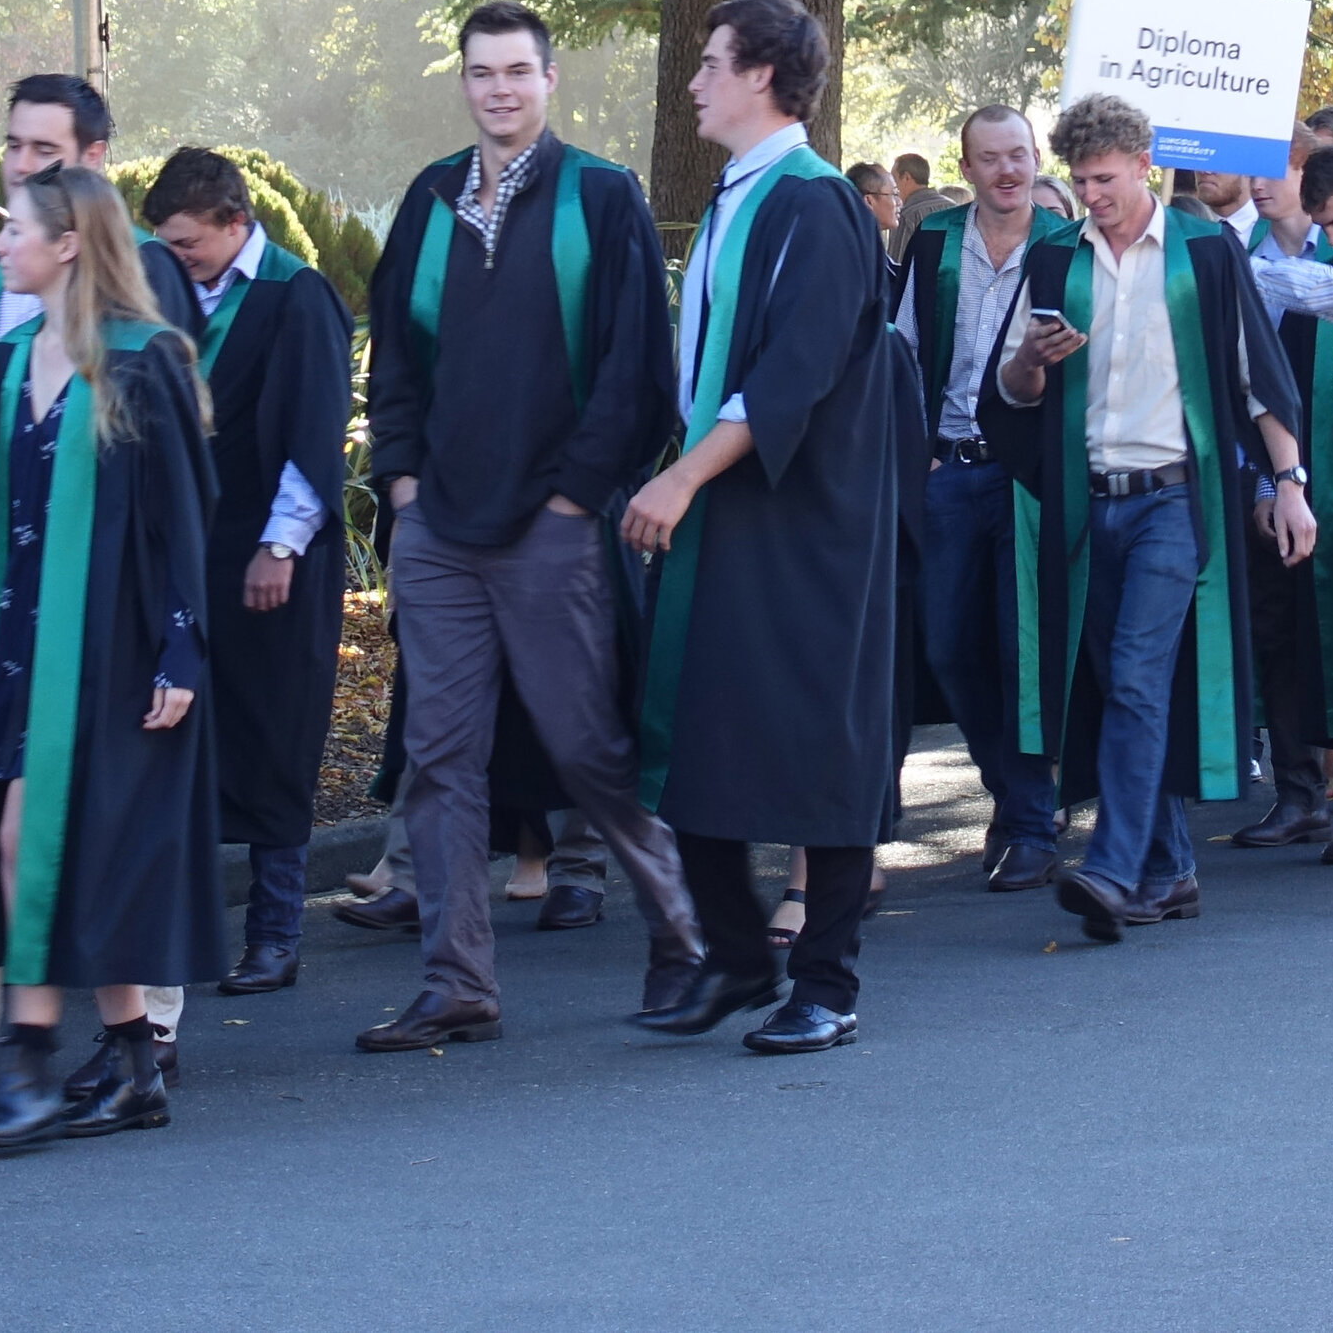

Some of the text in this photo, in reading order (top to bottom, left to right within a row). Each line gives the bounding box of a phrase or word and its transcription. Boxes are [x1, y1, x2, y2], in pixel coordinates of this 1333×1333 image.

[1137, 27, 1241, 60] Diploma
[1098, 55, 1270, 96] in Agriculture
